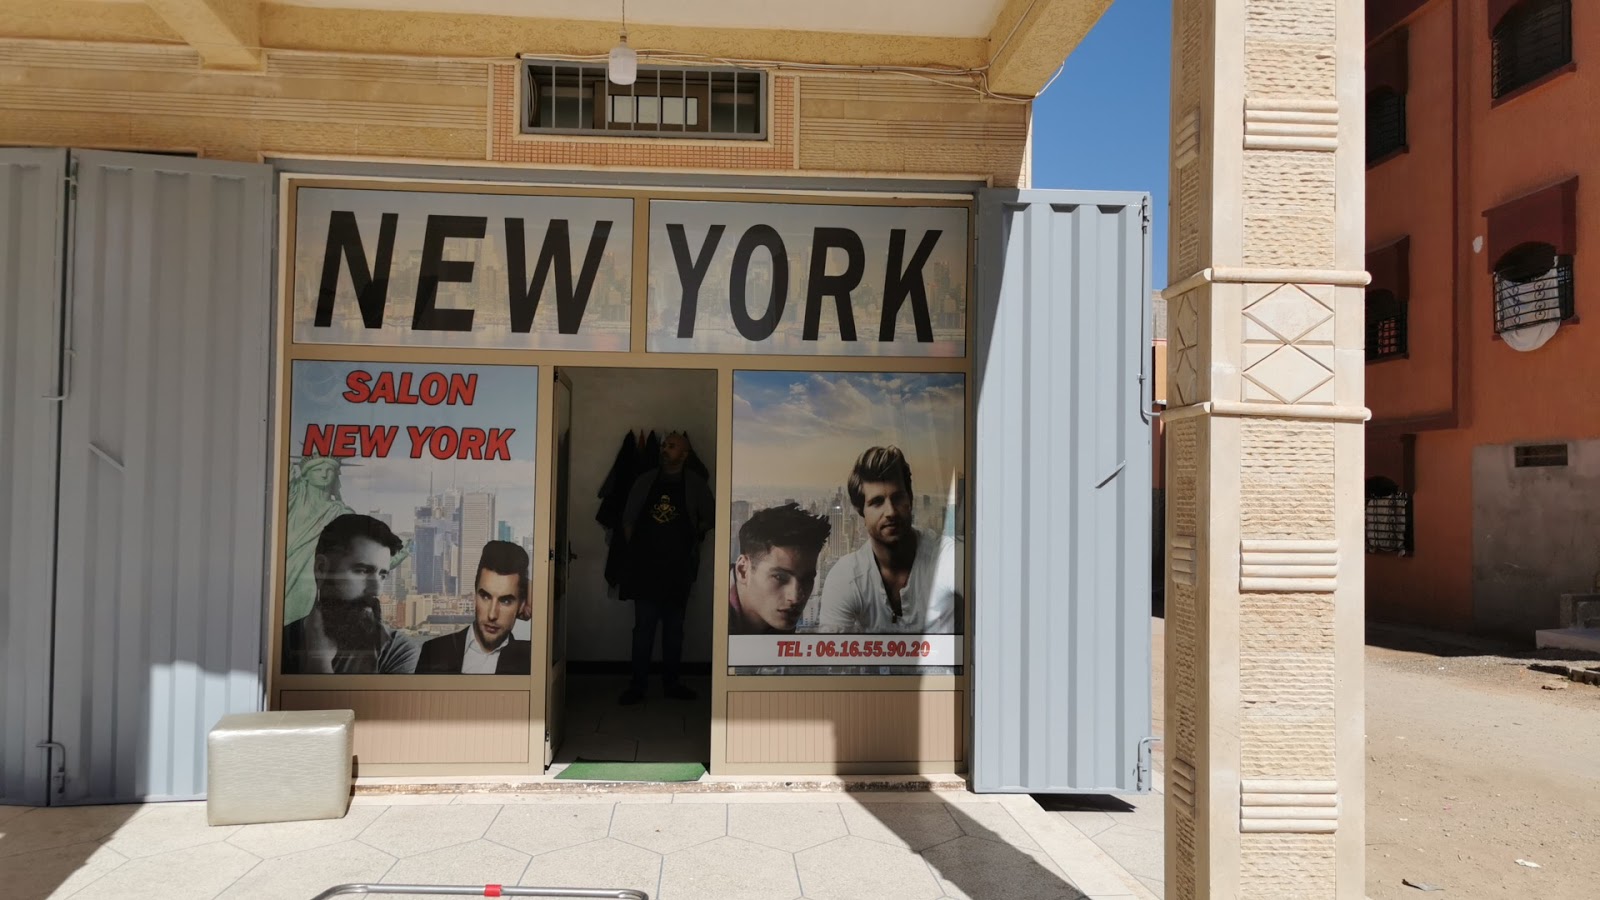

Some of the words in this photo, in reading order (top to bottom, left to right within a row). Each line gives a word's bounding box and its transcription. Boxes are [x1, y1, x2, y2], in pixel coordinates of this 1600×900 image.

[314, 210, 613, 334] NEW
[666, 223, 943, 343] YORK
[342, 370, 478, 405] SALON
[302, 424, 399, 457] NEW
[407, 426, 516, 460] YORK
[815, 640, 931, 657] 06.16.55.90.20
